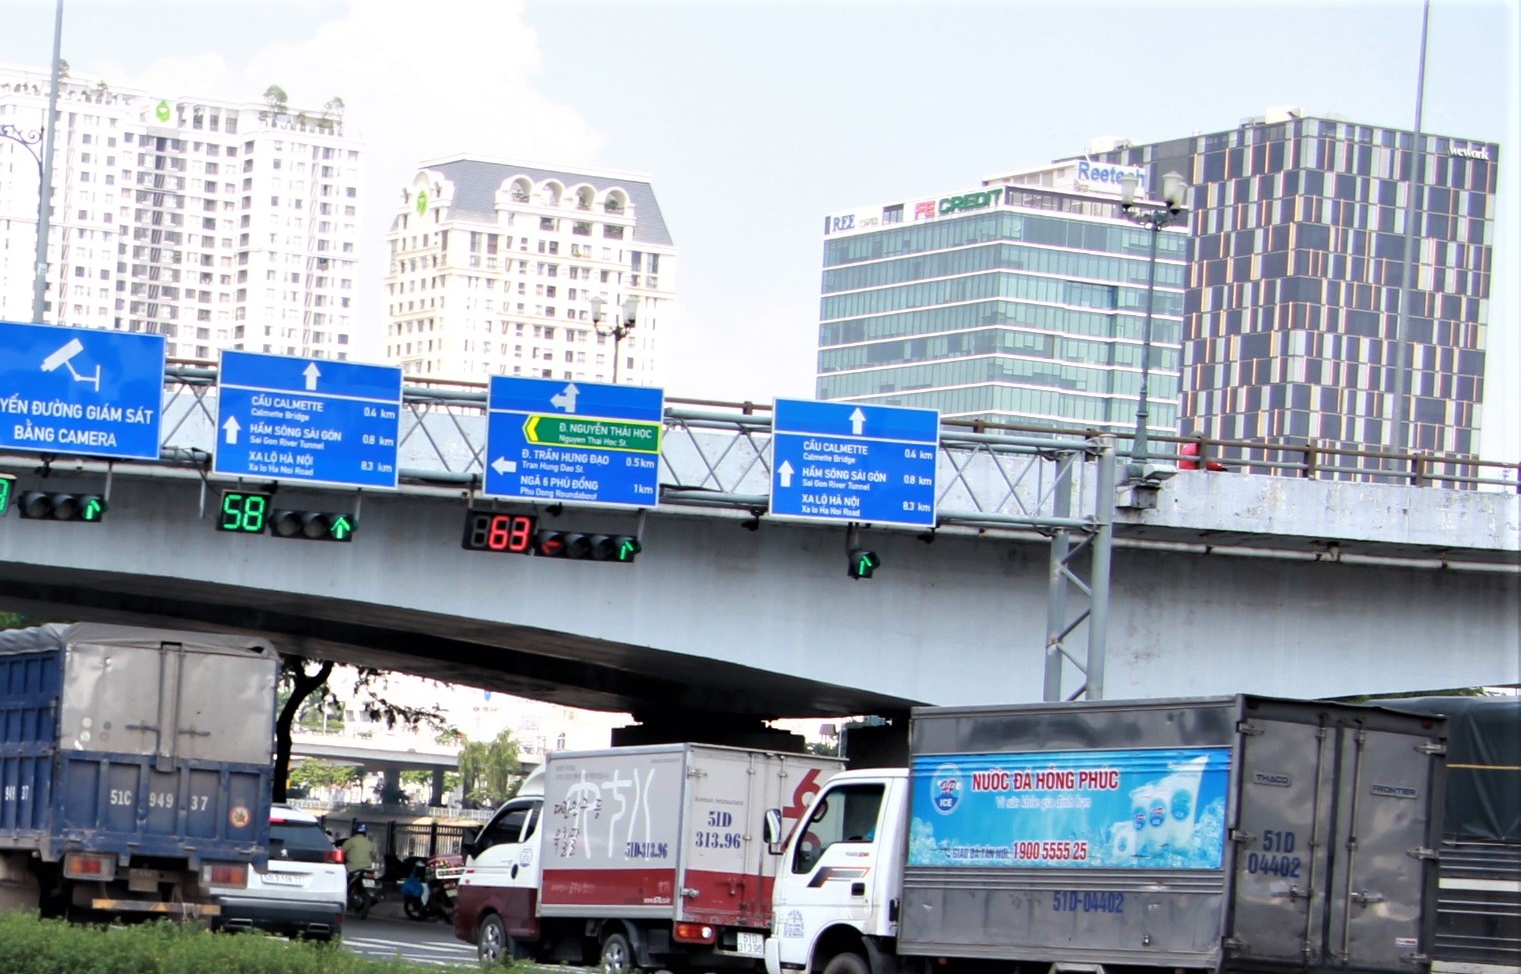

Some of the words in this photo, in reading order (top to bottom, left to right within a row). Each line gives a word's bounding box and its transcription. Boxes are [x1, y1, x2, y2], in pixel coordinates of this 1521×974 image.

[1079, 161, 1145, 187] Reeteh
[939, 189, 1003, 214] CREDIT
[833, 215, 855, 231] REE
[251, 394, 272, 406] CẦU
[274, 398, 324, 412] CALMETTE
[32, 399, 82, 418] ĐƯỜNG
[86, 404, 121, 421] GIÁM
[125, 406, 153, 424] SÁT
[364, 407, 377, 417] 0.4
[381, 408, 395, 419] km
[14, 419, 54, 442] BẰNG
[59, 429, 117, 447] CAMERA
[250, 422, 273, 434] HẦM
[274, 424, 301, 437] SÔNG
[303, 426, 319, 438] SÀI
[611, 426, 630, 437] THÁI
[633, 429, 652, 440] HỌC
[362, 435, 375, 445] 0.8
[380, 436, 394, 446] km
[803, 439, 821, 451] CẦU
[823, 442, 868, 455] CALMETTE
[249, 452, 263, 461] XA
[265, 451, 277, 465] LỘ
[280, 452, 294, 464] HÀ
[297, 454, 313, 467] NỘI
[522, 449, 531, 459] Đ.
[534, 448, 559, 461] TRẦN
[561, 451, 588, 463] HƯNG
[590, 455, 609, 466] ĐẠO
[905, 449, 916, 459] 0.4
[920, 450, 932, 459] km
[378, 462, 392, 472] km
[802, 465, 823, 478] HẦM
[825, 468, 849, 480] SÔNG
[851, 470, 866, 481] SÀI
[868, 473, 886, 483] GÒN
[521, 474, 541, 487] NGÃ
[543, 477, 548, 487] 6
[551, 477, 570, 488] PHÙ
[904, 475, 915, 485] 0.8
[919, 476, 931, 486] km
[802, 494, 814, 503] XA
[816, 494, 827, 508] LỘ
[830, 494, 841, 506] HÀ
[844, 496, 859, 509] NỘI
[903, 502, 914, 511] 8.3
[918, 503, 930, 512] km
[223, 494, 265, 532] 58
[488, 515, 531, 552] 63
[972, 767, 1010, 790] NƯỚC
[1013, 767, 1032, 790] ĐÁ
[1036, 763, 1074, 790] HỒNG
[1079, 766, 1119, 789] PHÚC
[21, 785, 29, 800] 37
[1372, 785, 1417, 797] FRONTIER
[110, 789, 131, 806] 51C
[149, 792, 174, 808] 949
[191, 795, 208, 811] 37
[940, 798, 952, 807] ICE
[708, 810, 732, 827] 51D
[696, 831, 741, 849] 313.96
[1263, 830, 1295, 853] 51D
[1013, 842, 1040, 860] 1900
[1042, 842, 1071, 860] 5555
[1073, 841, 1087, 860] 25
[1248, 853, 1301, 879] 04402
[1053, 891, 1124, 913] 51D-04402
[743, 932, 757, 943] 51D
